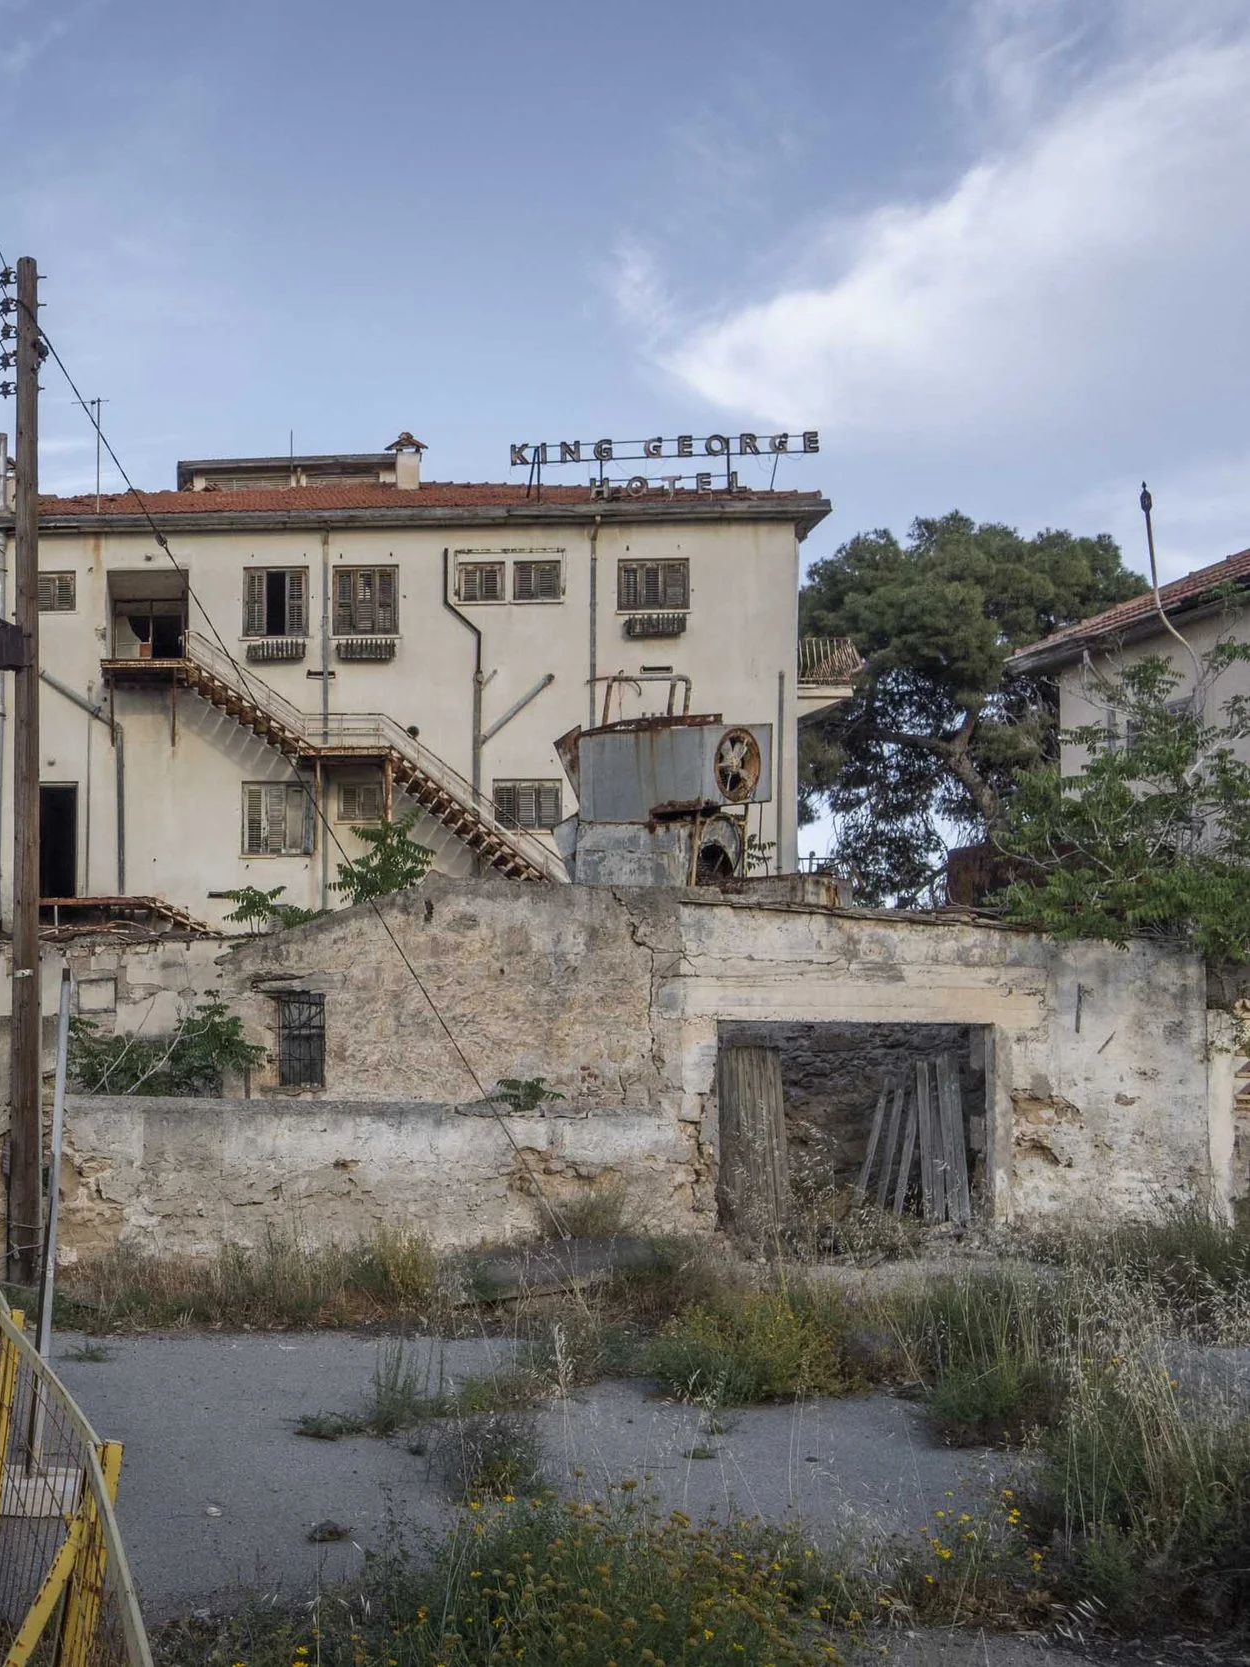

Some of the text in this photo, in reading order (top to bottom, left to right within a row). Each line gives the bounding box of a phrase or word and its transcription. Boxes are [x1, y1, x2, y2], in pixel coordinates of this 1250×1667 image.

[510, 431, 820, 466] KING GEORGE
[589, 471, 748, 500] HOTEL
